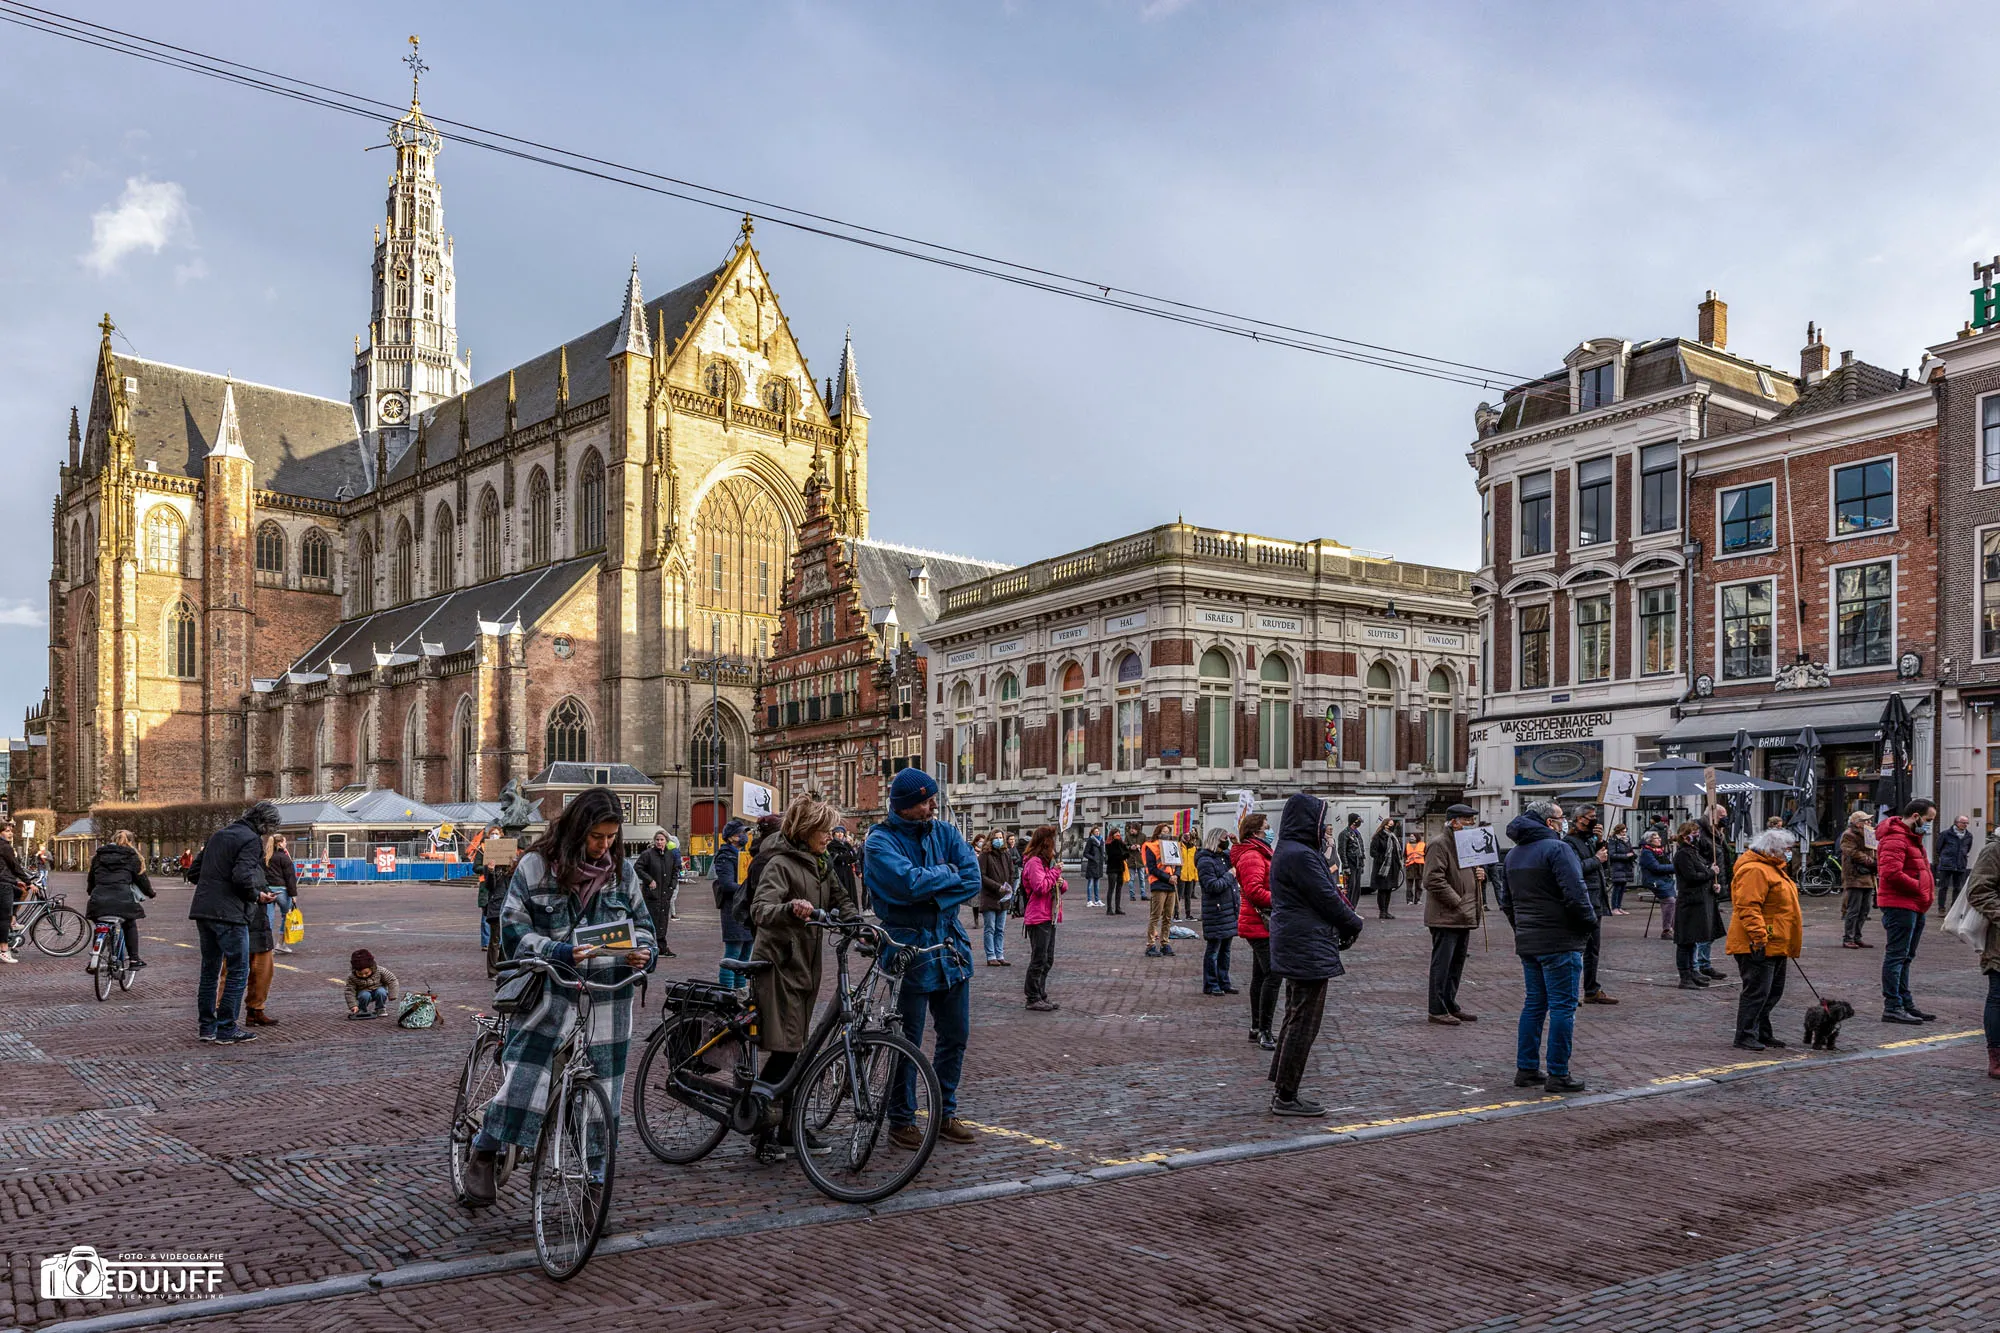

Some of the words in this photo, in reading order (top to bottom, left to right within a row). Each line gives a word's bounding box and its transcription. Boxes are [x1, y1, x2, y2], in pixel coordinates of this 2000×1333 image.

[1120, 619, 1133, 628] HAL
[1205, 613, 1234, 623] ISRAËLS
[1262, 619, 1296, 630] KRUYDER
[1058, 628, 1083, 640] VERWEY
[1367, 629, 1399, 639] SLUYTERS
[1428, 636, 1440, 644] VAN
[1441, 637, 1458, 646] LOOY
[1000, 643, 1017, 653] KUNST
[951, 651, 976, 663] MODERNE
[1500, 712, 1612, 733] VAKSCHOENMAKERIJ
[1470, 729, 1488, 743] CARE
[1515, 727, 1593, 742] SLEUTELSERVICE
[1758, 736, 1786, 748] BAMBU
[379, 854, 395, 866] SP
